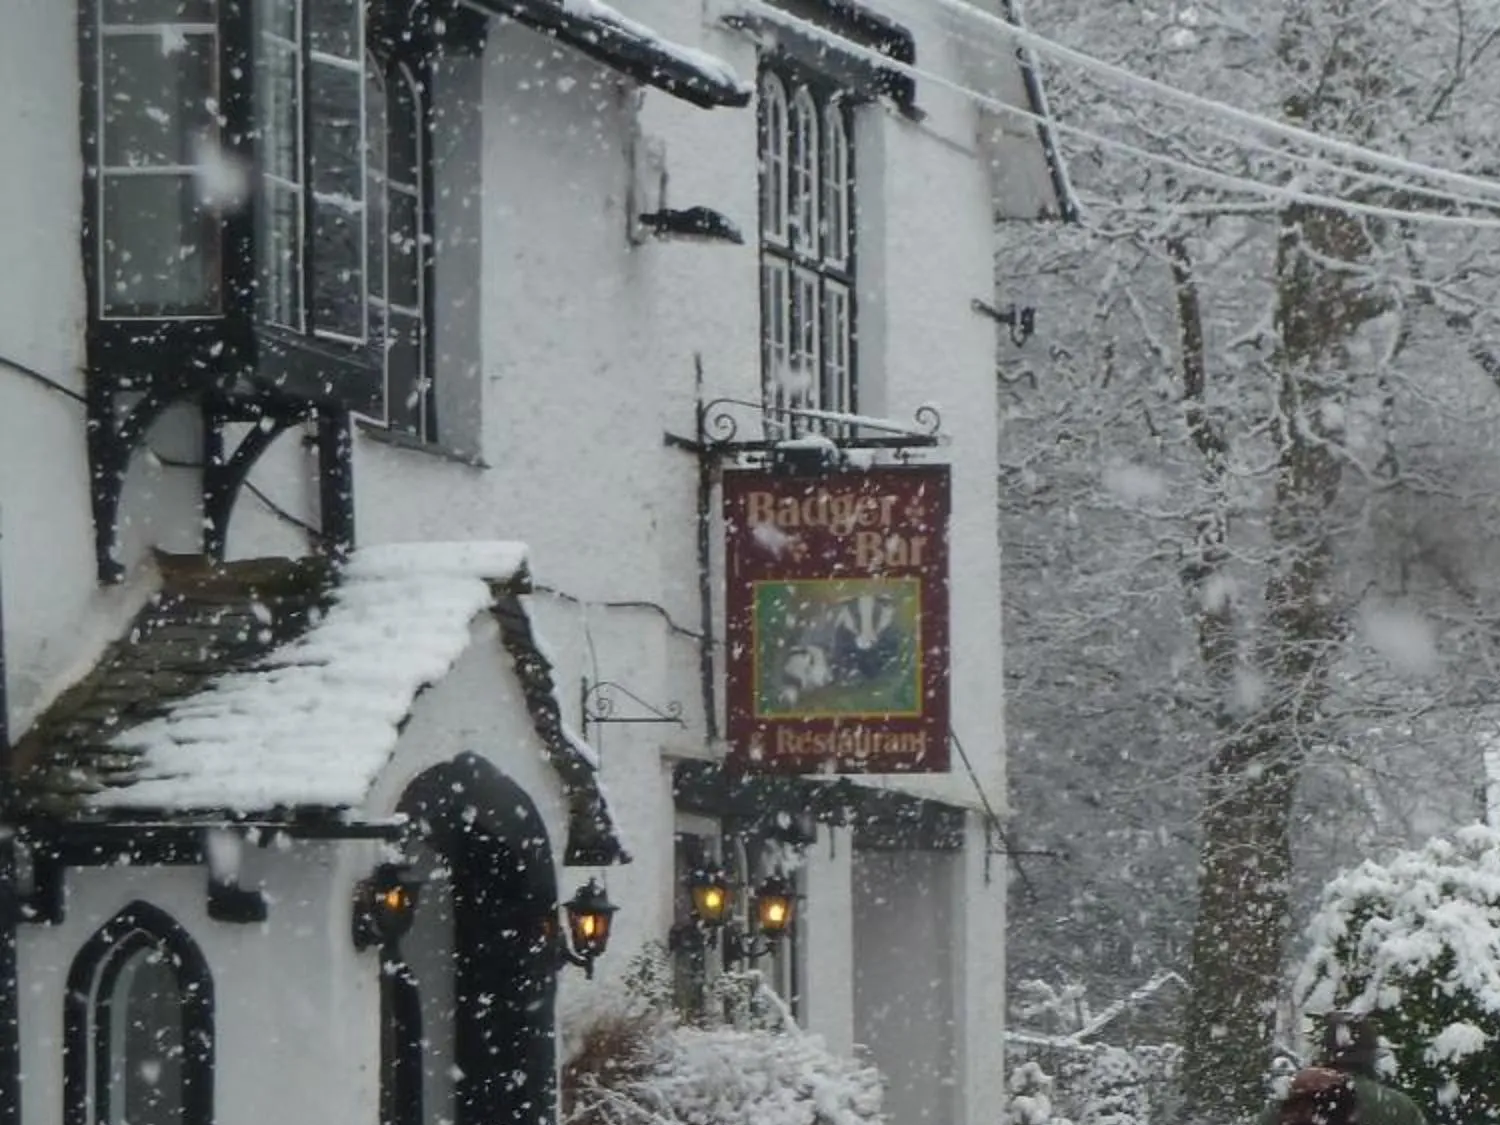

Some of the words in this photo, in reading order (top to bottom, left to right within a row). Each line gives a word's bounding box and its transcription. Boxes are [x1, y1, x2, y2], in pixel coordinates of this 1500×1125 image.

[746, 488, 896, 535] Badger
[854, 531, 928, 567] Bar
[776, 729, 927, 754] Restaurant
